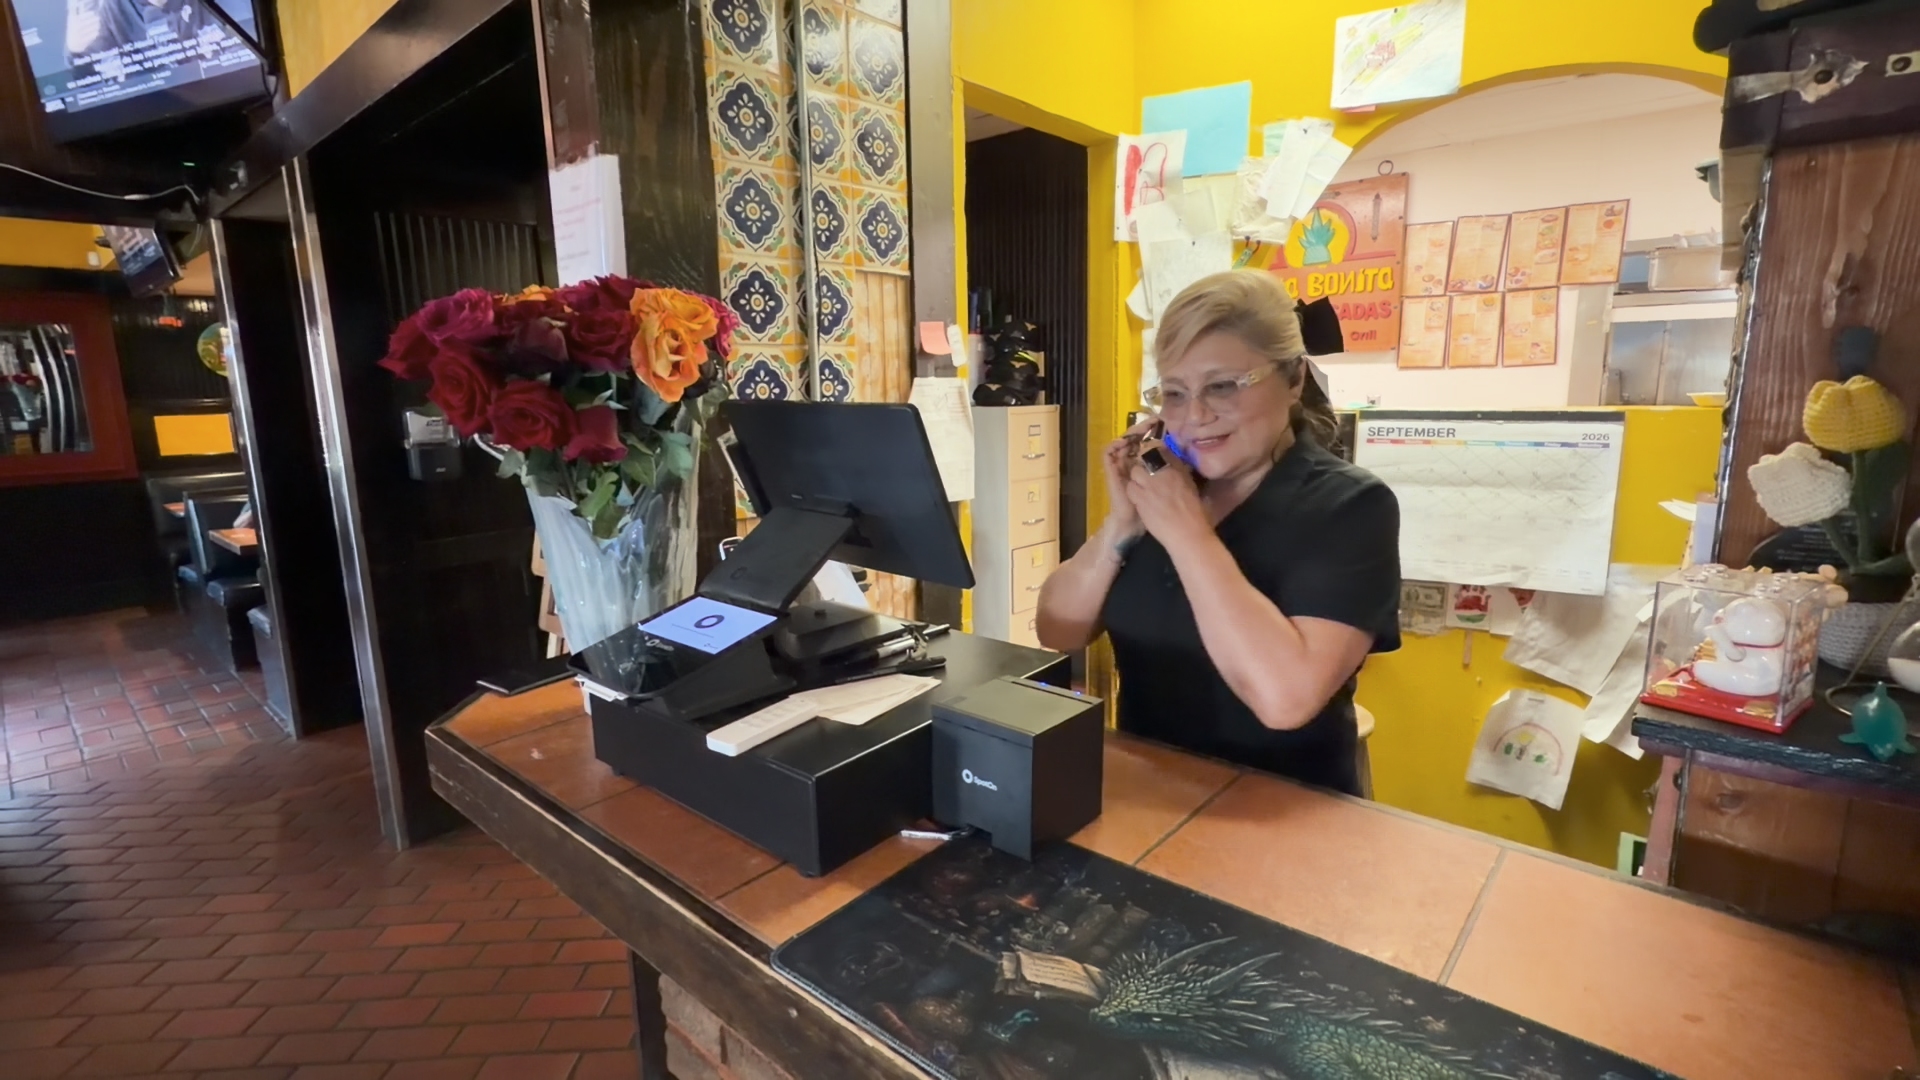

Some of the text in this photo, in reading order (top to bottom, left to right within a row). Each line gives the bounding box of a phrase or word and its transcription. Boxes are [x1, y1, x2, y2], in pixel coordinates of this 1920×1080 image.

[1333, 300, 1392, 321] ADAS
[1367, 426, 1610, 441] SEPTEMBER 2026
